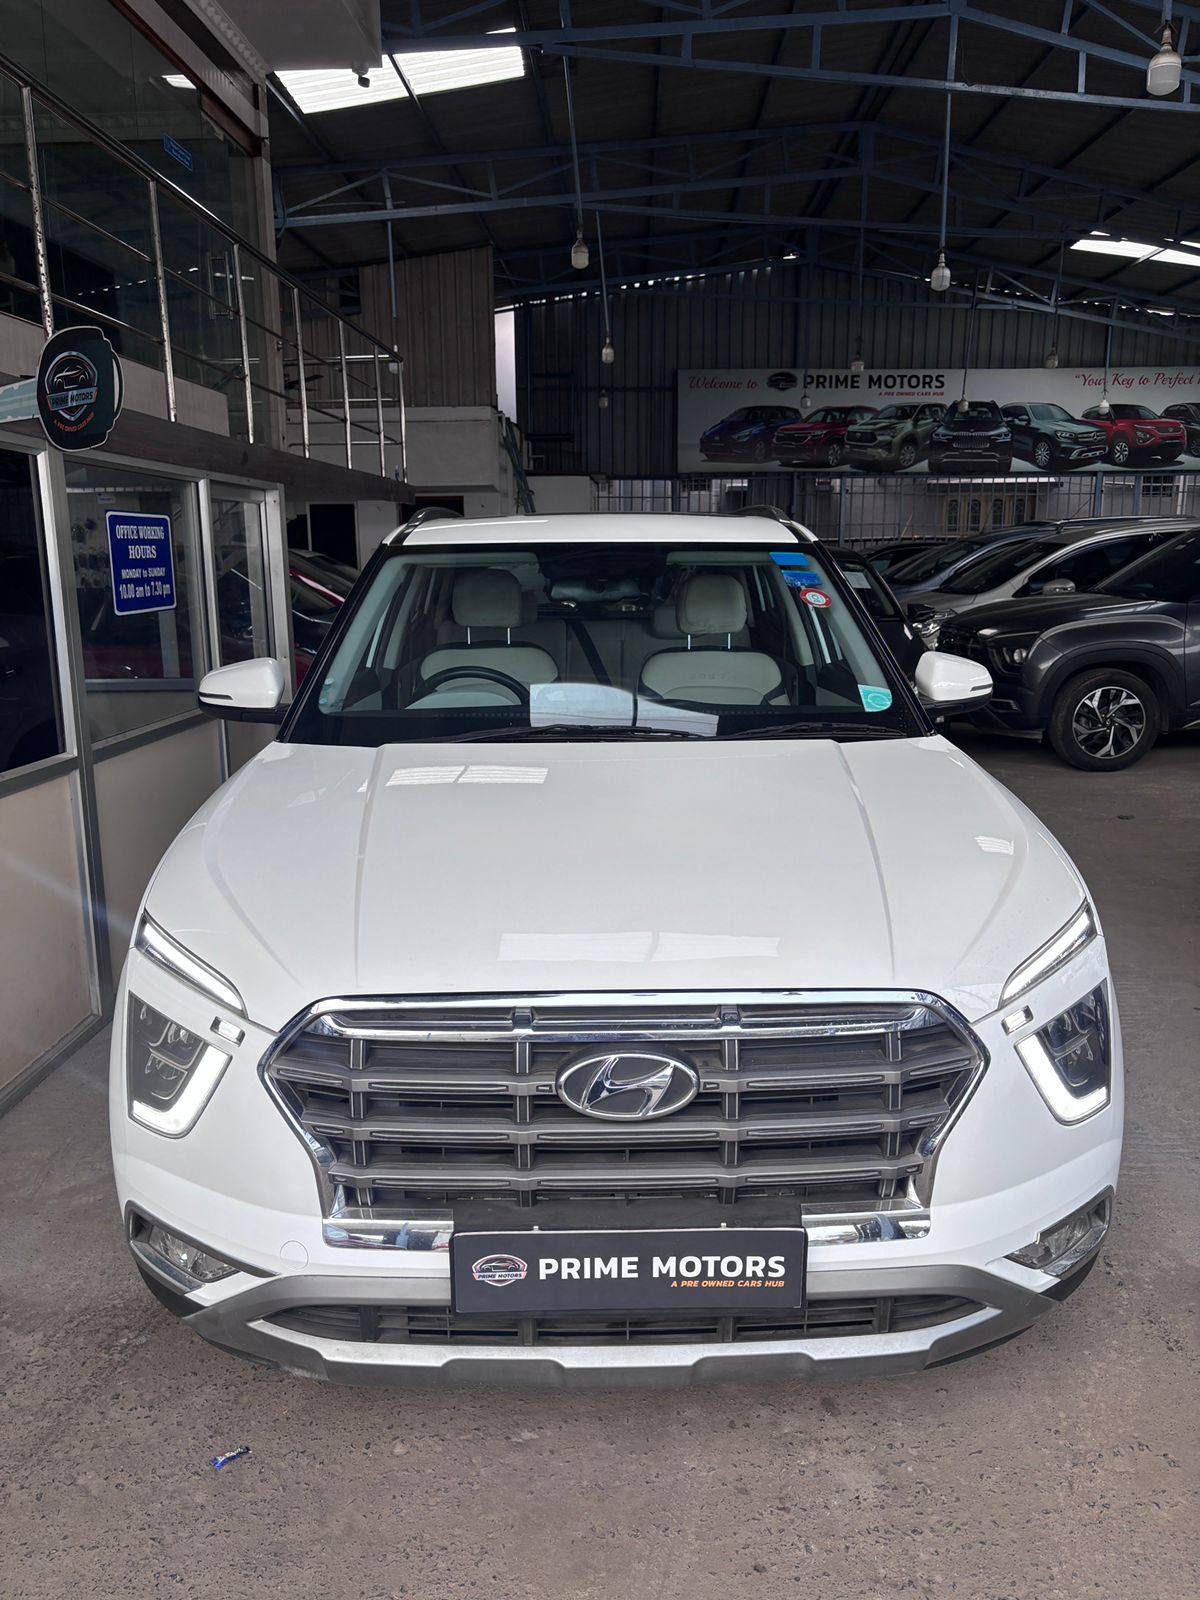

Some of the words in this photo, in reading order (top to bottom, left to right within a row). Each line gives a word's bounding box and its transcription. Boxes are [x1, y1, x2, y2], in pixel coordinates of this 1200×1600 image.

[688, 376, 743, 389] Welcome
[747, 378, 758, 389] to
[803, 374, 861, 389] PRIME
[868, 374, 945, 389] MOTORS
[1112, 373, 1135, 388] Key
[1138, 374, 1150, 385] to
[1154, 371, 1194, 388] Perfect
[70, 392, 93, 403] MOTORS
[116, 525, 138, 539] OFFICE
[138, 526, 164, 539] WORKING
[128, 545, 157, 559] HOURS
[121, 569, 142, 579] MONDAY
[143, 569, 148, 578] to
[148, 567, 165, 577] SUNDAY
[120, 584, 135, 599] 10.00
[136, 586, 144, 598] am
[145, 584, 151, 597] to
[151, 581, 162, 596] 7.30
[163, 584, 171, 598] pm
[539, 1257, 639, 1280] PRIME
[652, 1255, 786, 1278] MOTORS
[670, 1280, 678, 1288] A
[680, 1280, 699, 1288] PRE
[701, 1280, 735, 1288] OWNED
